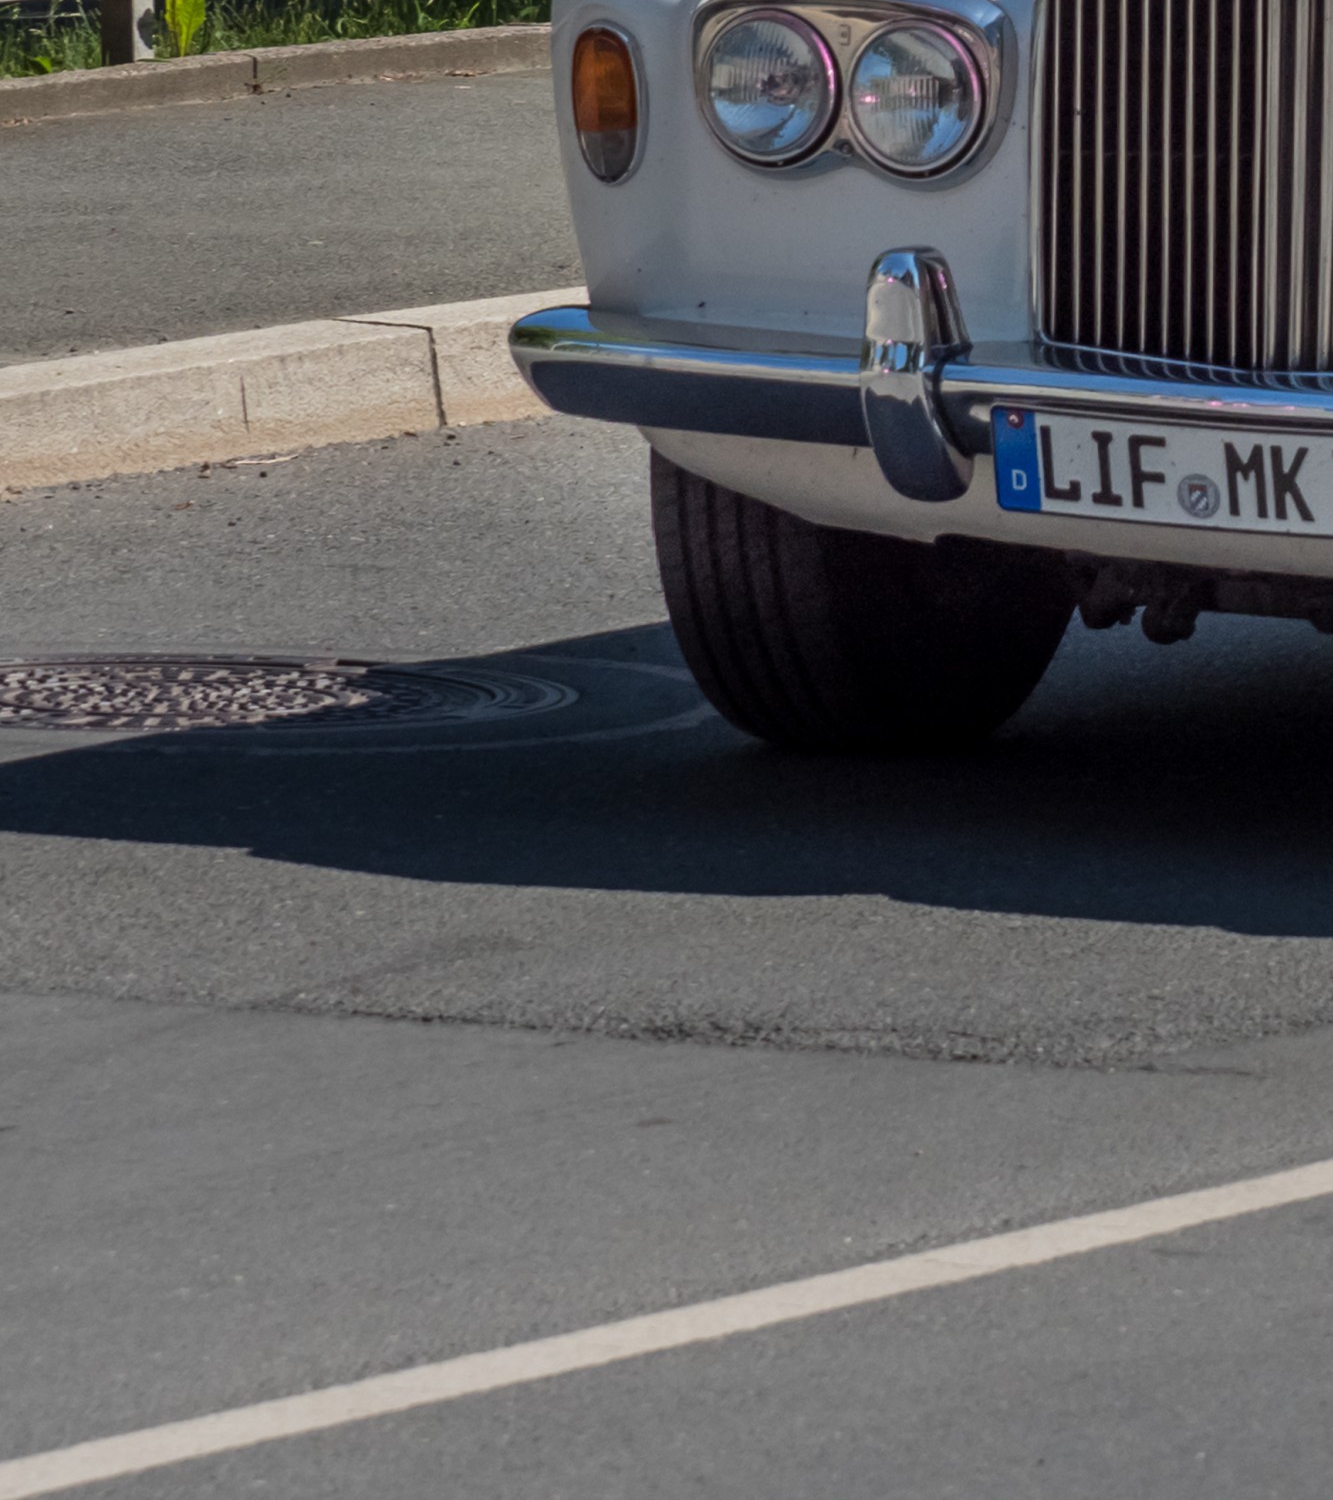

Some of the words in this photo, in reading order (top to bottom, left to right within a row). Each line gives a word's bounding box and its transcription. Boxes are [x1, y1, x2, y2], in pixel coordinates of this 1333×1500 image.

[1011, 469, 1028, 491] D
[1040, 425, 1166, 508] LIF
[1224, 442, 1315, 522] MK
